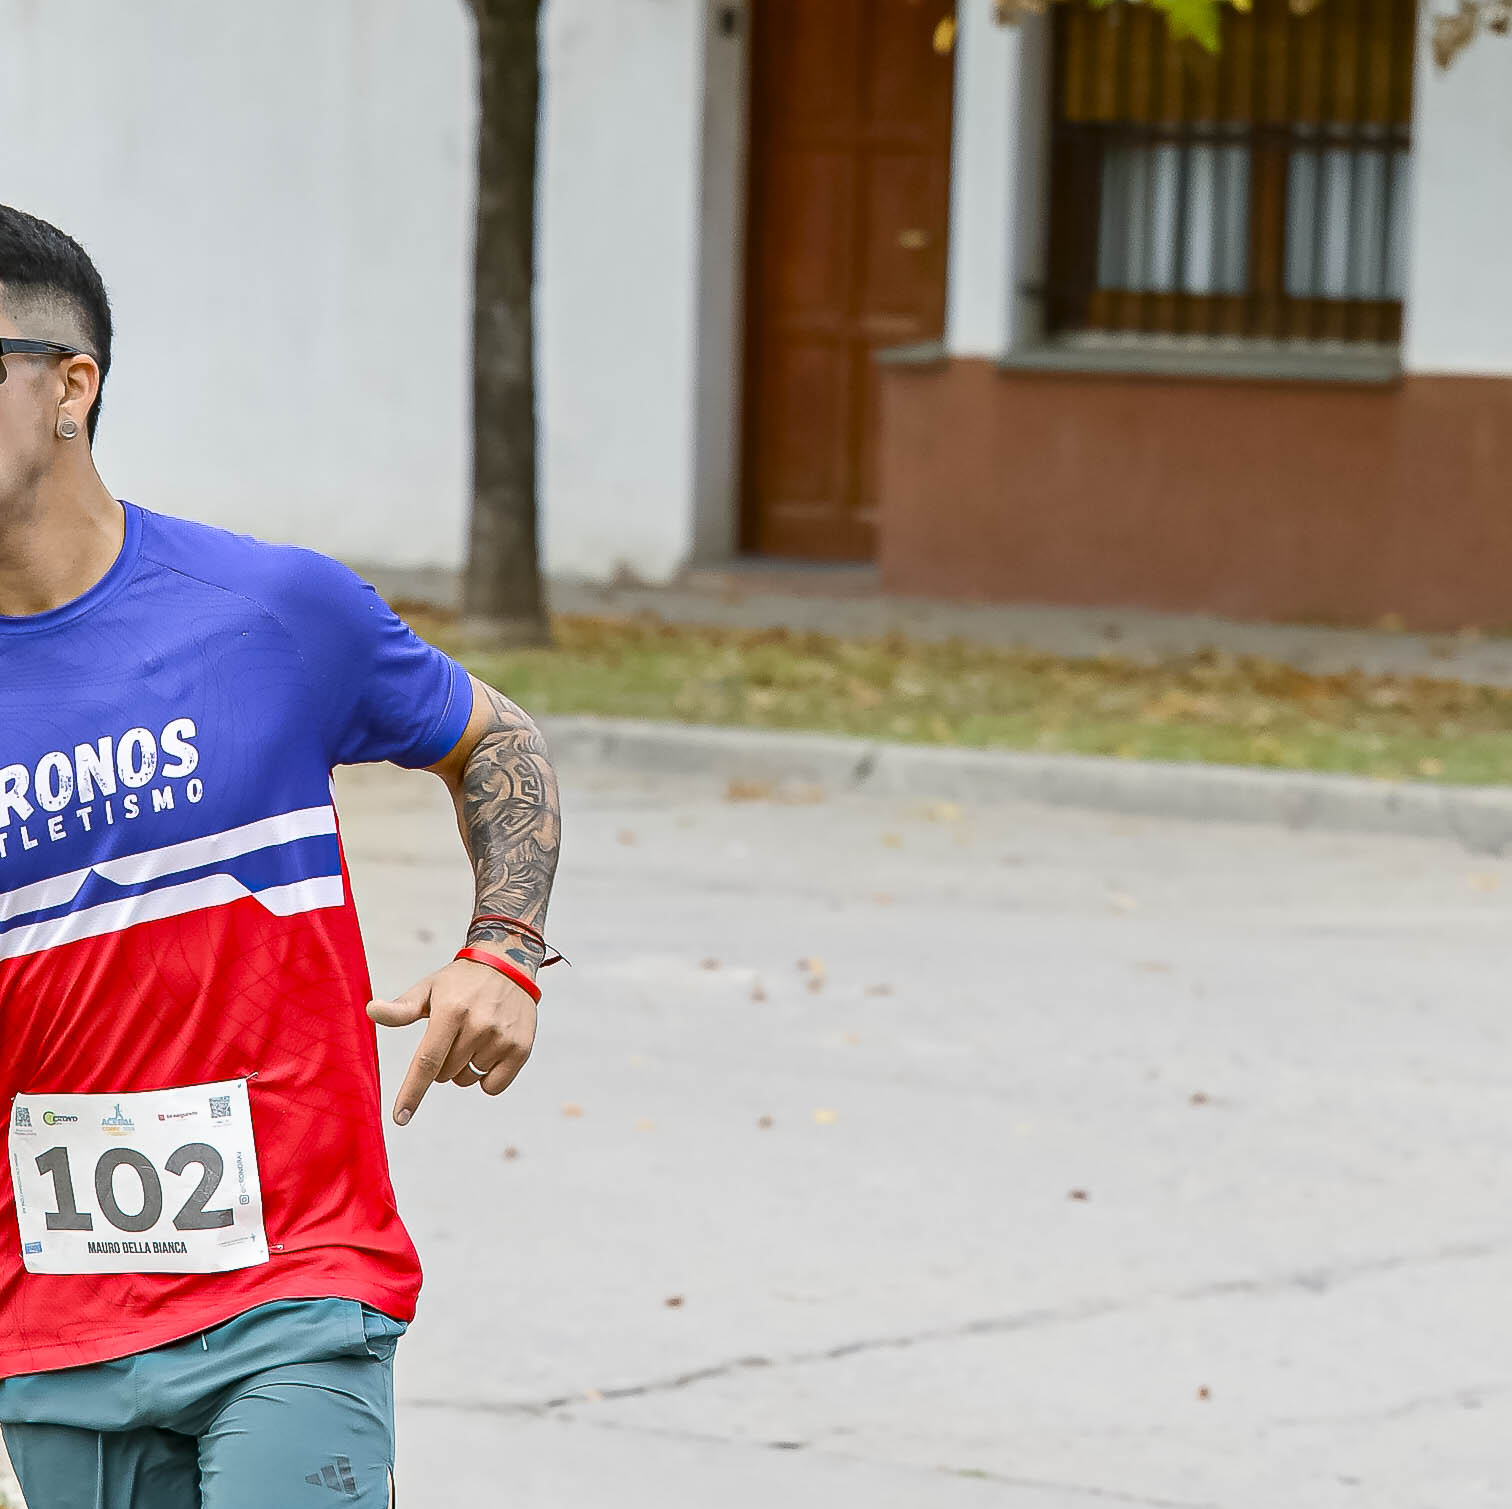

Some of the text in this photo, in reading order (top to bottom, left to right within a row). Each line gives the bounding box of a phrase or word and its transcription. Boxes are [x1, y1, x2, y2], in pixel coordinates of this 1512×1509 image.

[35, 1143, 234, 1233] 102
[88, 1241, 188, 1254] MAURO DELLA BIANCA
